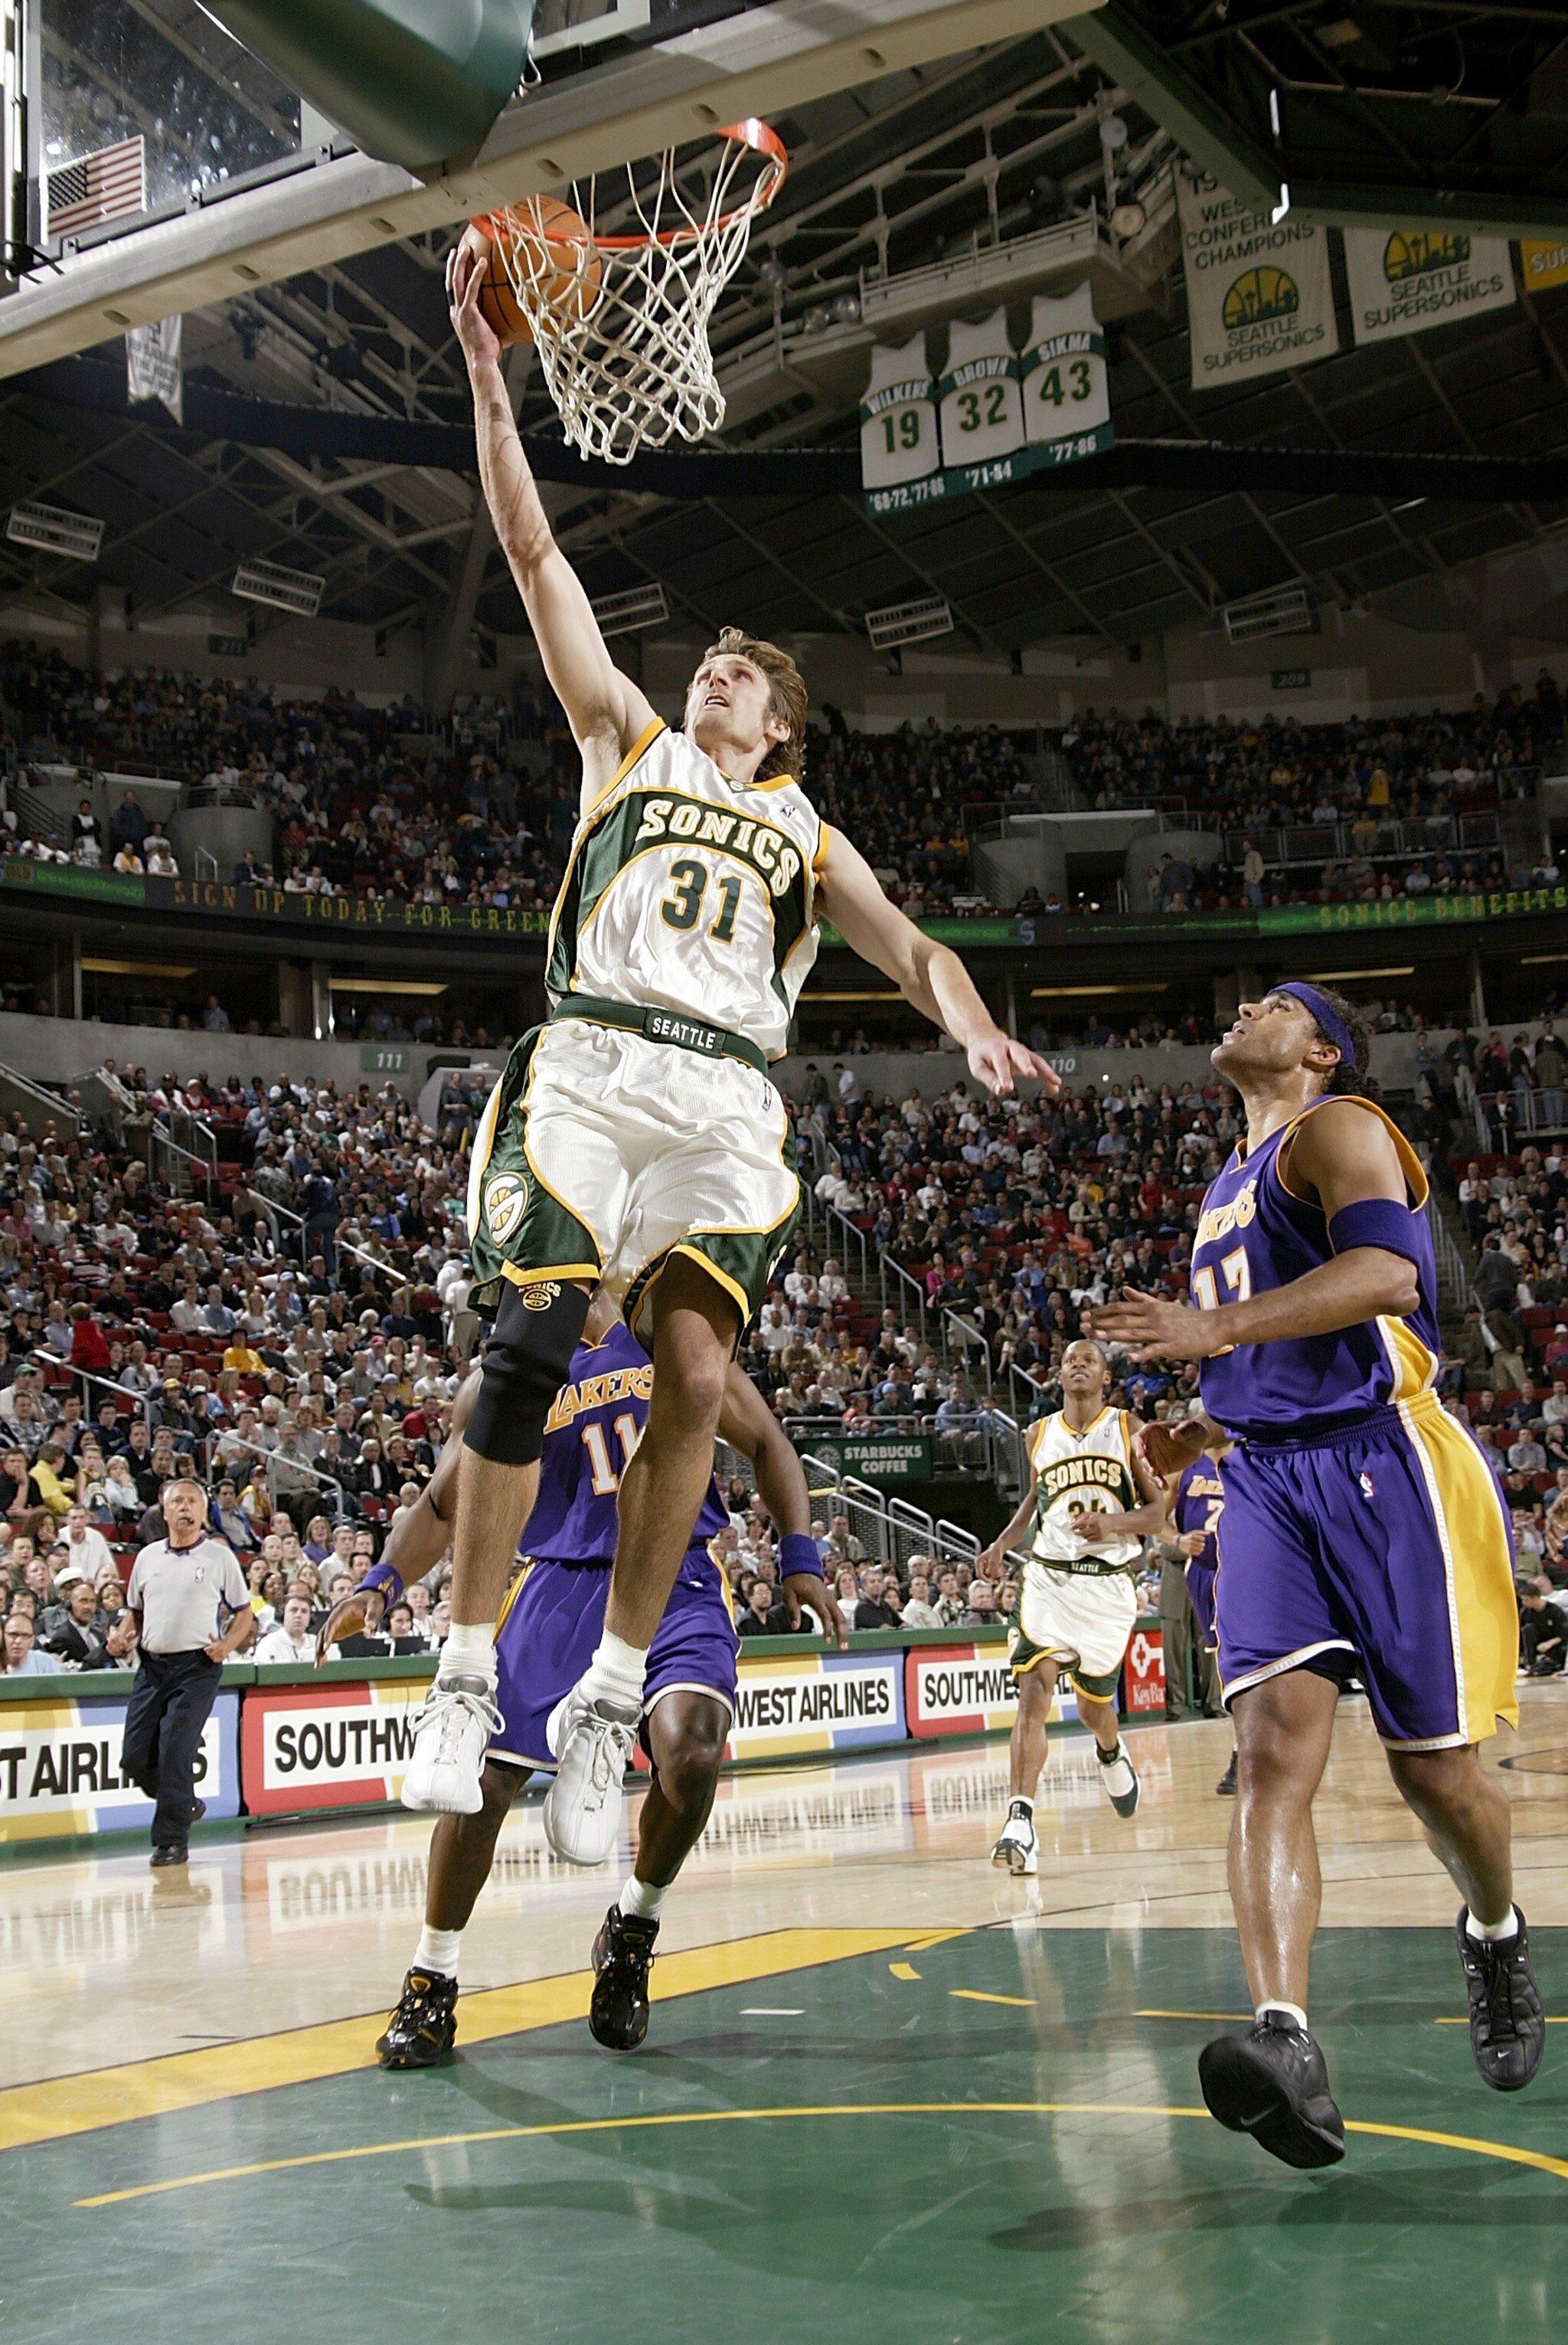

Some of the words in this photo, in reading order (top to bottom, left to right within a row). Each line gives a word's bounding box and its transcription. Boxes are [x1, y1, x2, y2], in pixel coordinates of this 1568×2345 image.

[1364, 274, 1504, 329] SUPERSONICS
[1390, 263, 1471, 302] SEATTLE
[1037, 334, 1091, 362] SIKMA
[1203, 323, 1325, 371] SUPERSONICS
[1228, 315, 1298, 347] SEATTLE
[953, 356, 1009, 387] BROWN
[1040, 360, 1091, 407] 43
[867, 380, 929, 414] WILKENS
[957, 384, 1008, 431] 32
[881, 410, 920, 453] 19
[635, 799, 800, 897] SONICS
[175, 880, 236, 908] SIGN
[255, 889, 285, 913] UP
[303, 894, 386, 924] TODAY
[405, 903, 452, 928] FOR
[661, 857, 744, 946] 31
[1320, 900, 1416, 928] SONICS
[652, 1017, 717, 1050] SEATTLE
[377, 1053, 403, 1069] 111
[1050, 1057, 1076, 1073] 110
[543, 1364, 655, 1435] LAKERS
[844, 1445, 922, 1459] STARBUCKS
[861, 1460, 908, 1474] COFFEE
[1044, 1458, 1122, 1497] SONICS
[1071, 1562, 1100, 1574] SEATTLE
[799, 1678, 890, 1723] AIRLINES
